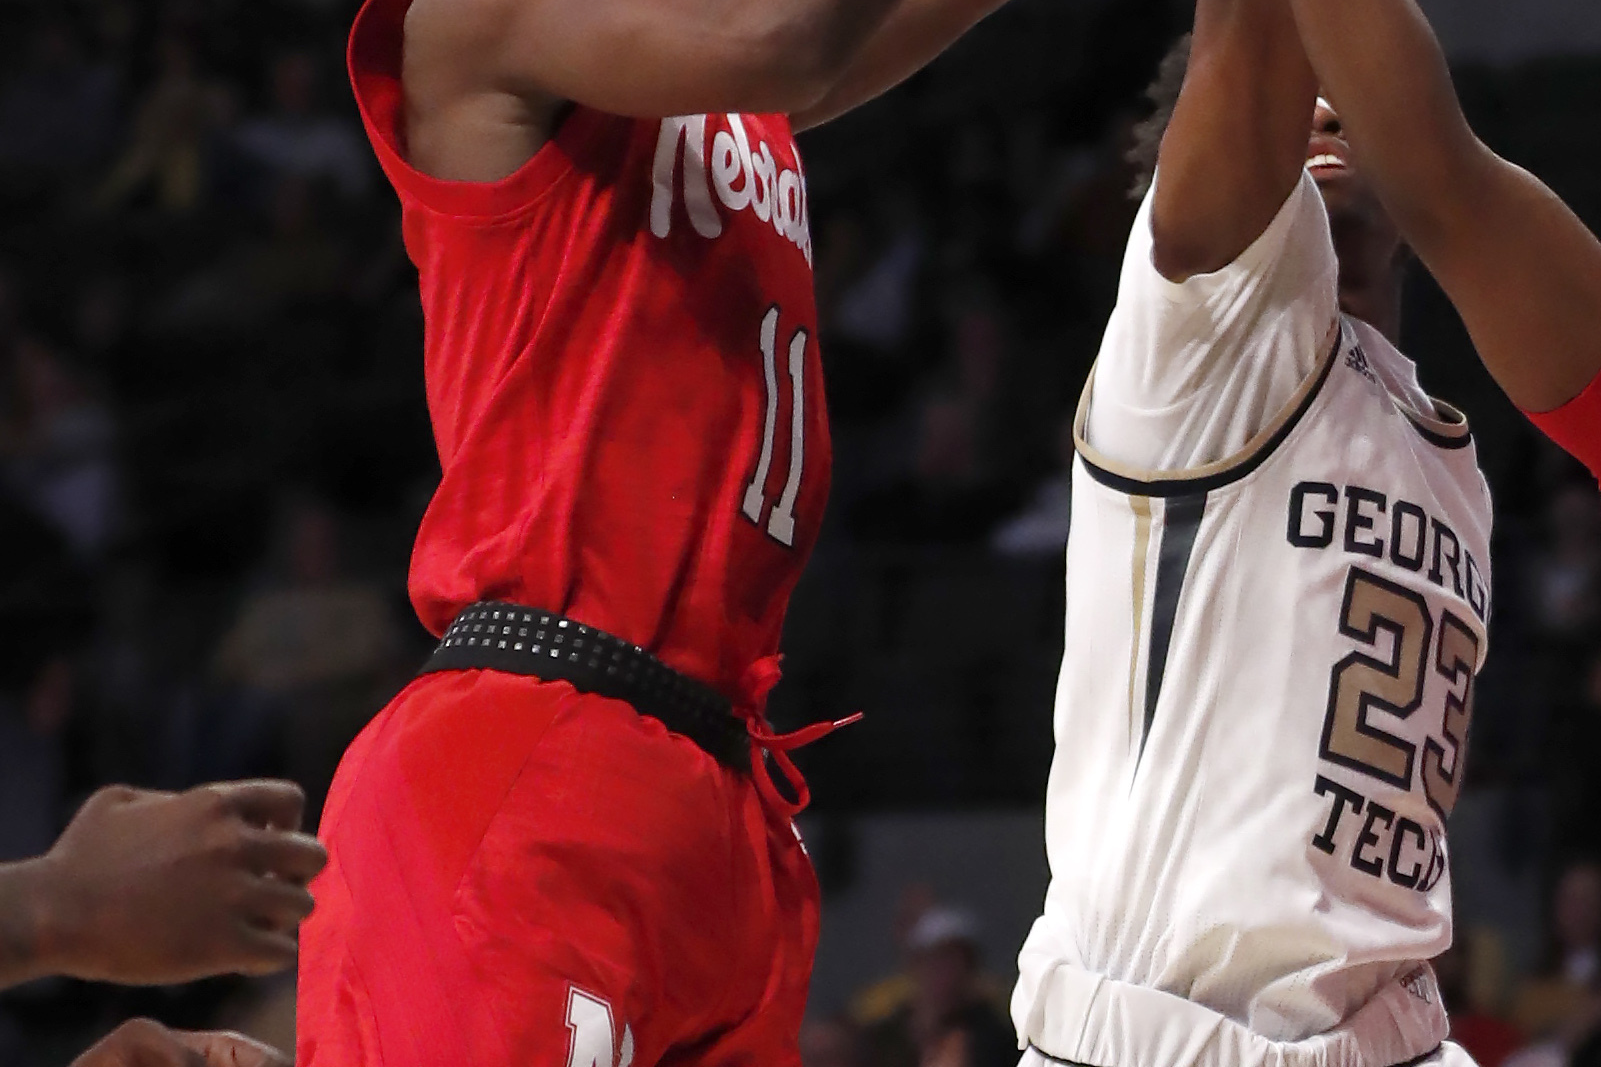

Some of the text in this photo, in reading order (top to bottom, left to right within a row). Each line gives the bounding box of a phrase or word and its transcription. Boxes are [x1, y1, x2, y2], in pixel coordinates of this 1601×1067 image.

[742, 303, 808, 548] 11
[1286, 480, 1491, 624] GEORG
[1318, 565, 1480, 824] 23
